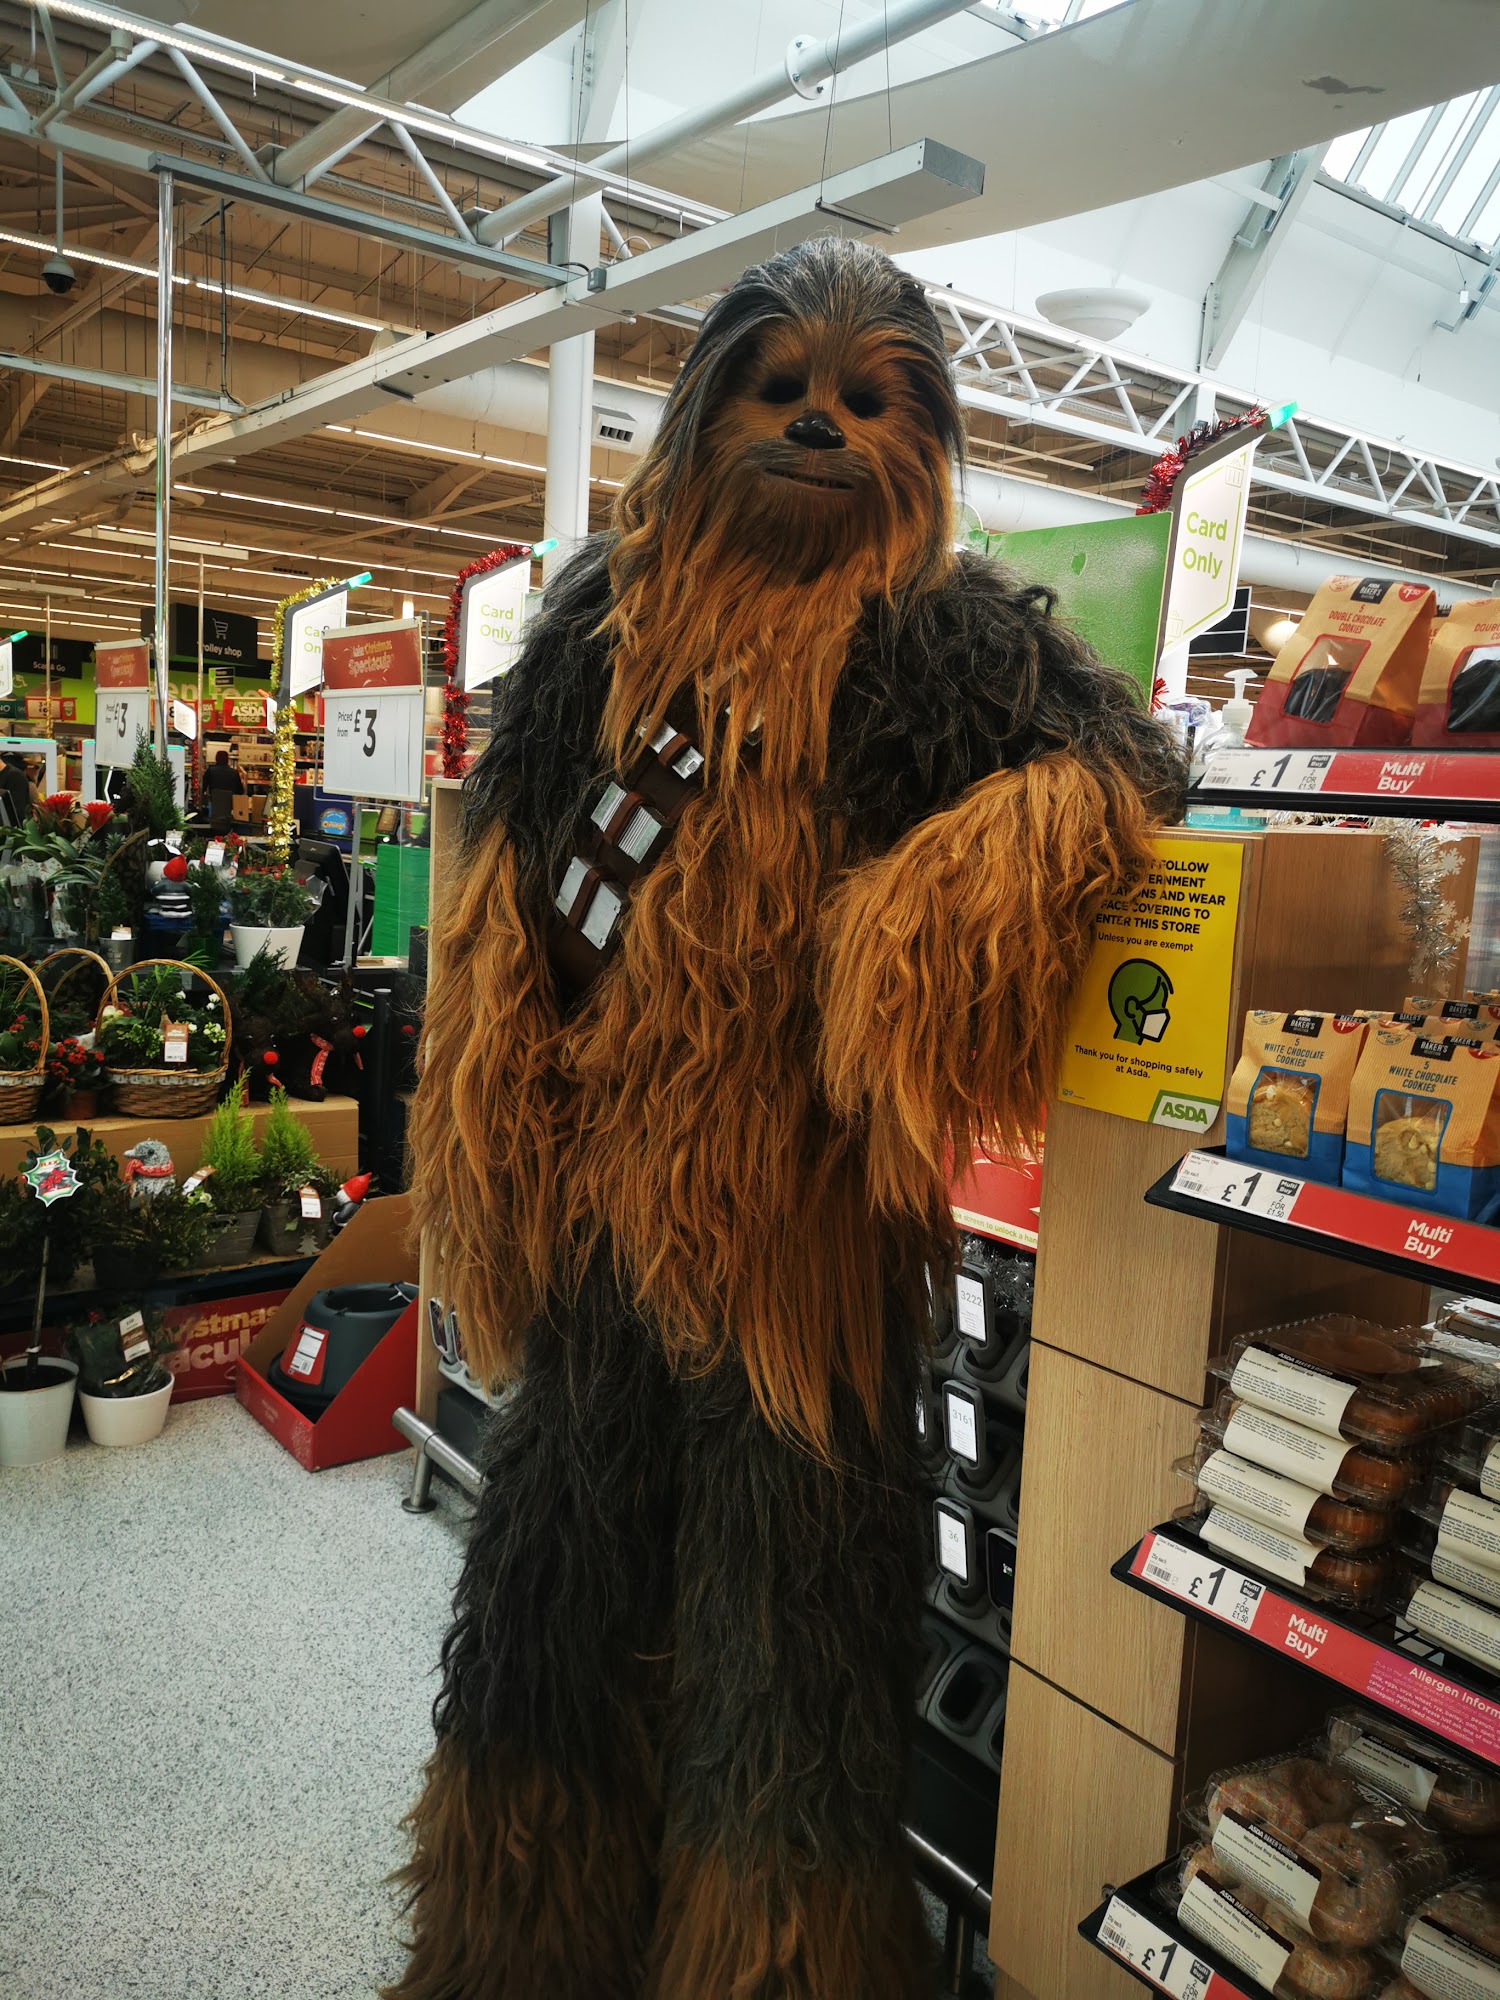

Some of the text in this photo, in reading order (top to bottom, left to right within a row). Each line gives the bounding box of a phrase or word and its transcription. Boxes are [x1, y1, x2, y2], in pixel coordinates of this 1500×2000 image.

[1187, 512, 1227, 541] Card
[1183, 547, 1223, 579] Only
[480, 604, 514, 620] Card
[1329, 610, 1386, 626] DOUBLE CHOCOLATE
[304, 626, 320, 637] Ca
[479, 624, 512, 642] Only
[1338, 623, 1364, 634] COOKIES
[198, 642, 242, 658] rolley shop
[304, 642, 321, 653] On
[56, 663, 66, 672] Go
[232, 706, 266, 716] ASDA
[114, 702, 128, 737] £3
[337, 708, 377, 757] Priced £3
[337, 728, 348, 737] from
[1250, 754, 1293, 787] £1
[1381, 762, 1426, 776] Multi
[1377, 776, 1415, 793] Buy
[1159, 890, 1185, 901] AND
[1189, 892, 1226, 906] WEAR
[1194, 909, 1210, 920] TO
[1096, 914, 1200, 934] ENTER THIS STORE
[1098, 932, 1124, 943] Unless
[1144, 939, 1158, 947] are
[1160, 941, 1193, 952] exempt
[1449, 1006, 1472, 1015] BAKER'S
[1290, 1020, 1316, 1030] BAKER'S
[1295, 1038, 1299, 1046] 5
[1420, 1042, 1448, 1053] BAKER'S
[1264, 1043, 1325, 1059] WHITE CHOCOLATE
[1075, 1045, 1203, 1078] Thank you for shopping safely
[1276, 1054, 1306, 1067] COOKIES
[1424, 1061, 1429, 1069] 5
[1127, 1068, 1150, 1078] Asda.
[1389, 1066, 1458, 1085] WHITE CHOCOLATE
[1402, 1079, 1436, 1092] COOKIES
[1161, 1102, 1208, 1125] ASDA
[1221, 1172, 1262, 1206] £1
[1281, 1181, 1297, 1189] Multi
[1267, 1208, 1284, 1218] £1.50
[1271, 1201, 1285, 1210] FOR
[986, 1222, 993, 1230] to
[995, 1225, 1017, 1238] unlock
[1407, 1220, 1454, 1243] Multi
[1404, 1236, 1442, 1259] Buy
[960, 1290, 983, 1308] 3222
[952, 1409, 973, 1428] 3161
[947, 1529, 959, 1543] 36
[1188, 1567, 1226, 1606] £1
[1242, 1588, 1255, 1597] Buy
[1244, 1580, 1259, 1591] Multi
[1235, 1603, 1249, 1615] FOR
[1232, 1611, 1249, 1624] £1.50
[1288, 1614, 1328, 1644] Multi
[1285, 1631, 1318, 1659] Buy
[1409, 1666, 1459, 1698] Allergen
[1366, 1685, 1394, 1702] colleagues
[1410, 1708, 1425, 1717] need
[1425, 1716, 1440, 1725] more
[1422, 1706, 1440, 1718] Please
[1440, 1716, 1451, 1724] just
[1462, 1727, 1473, 1735] one
[1248, 1824, 1282, 1849] ASDA BAKER'S
[1220, 1890, 1252, 1918] ASDA BAKER'S
[1141, 1942, 1178, 1982] £1
[1193, 1962, 1209, 1975] Multi
[1192, 1969, 1205, 1980] Buy
[1185, 1983, 1198, 1998] FOR
